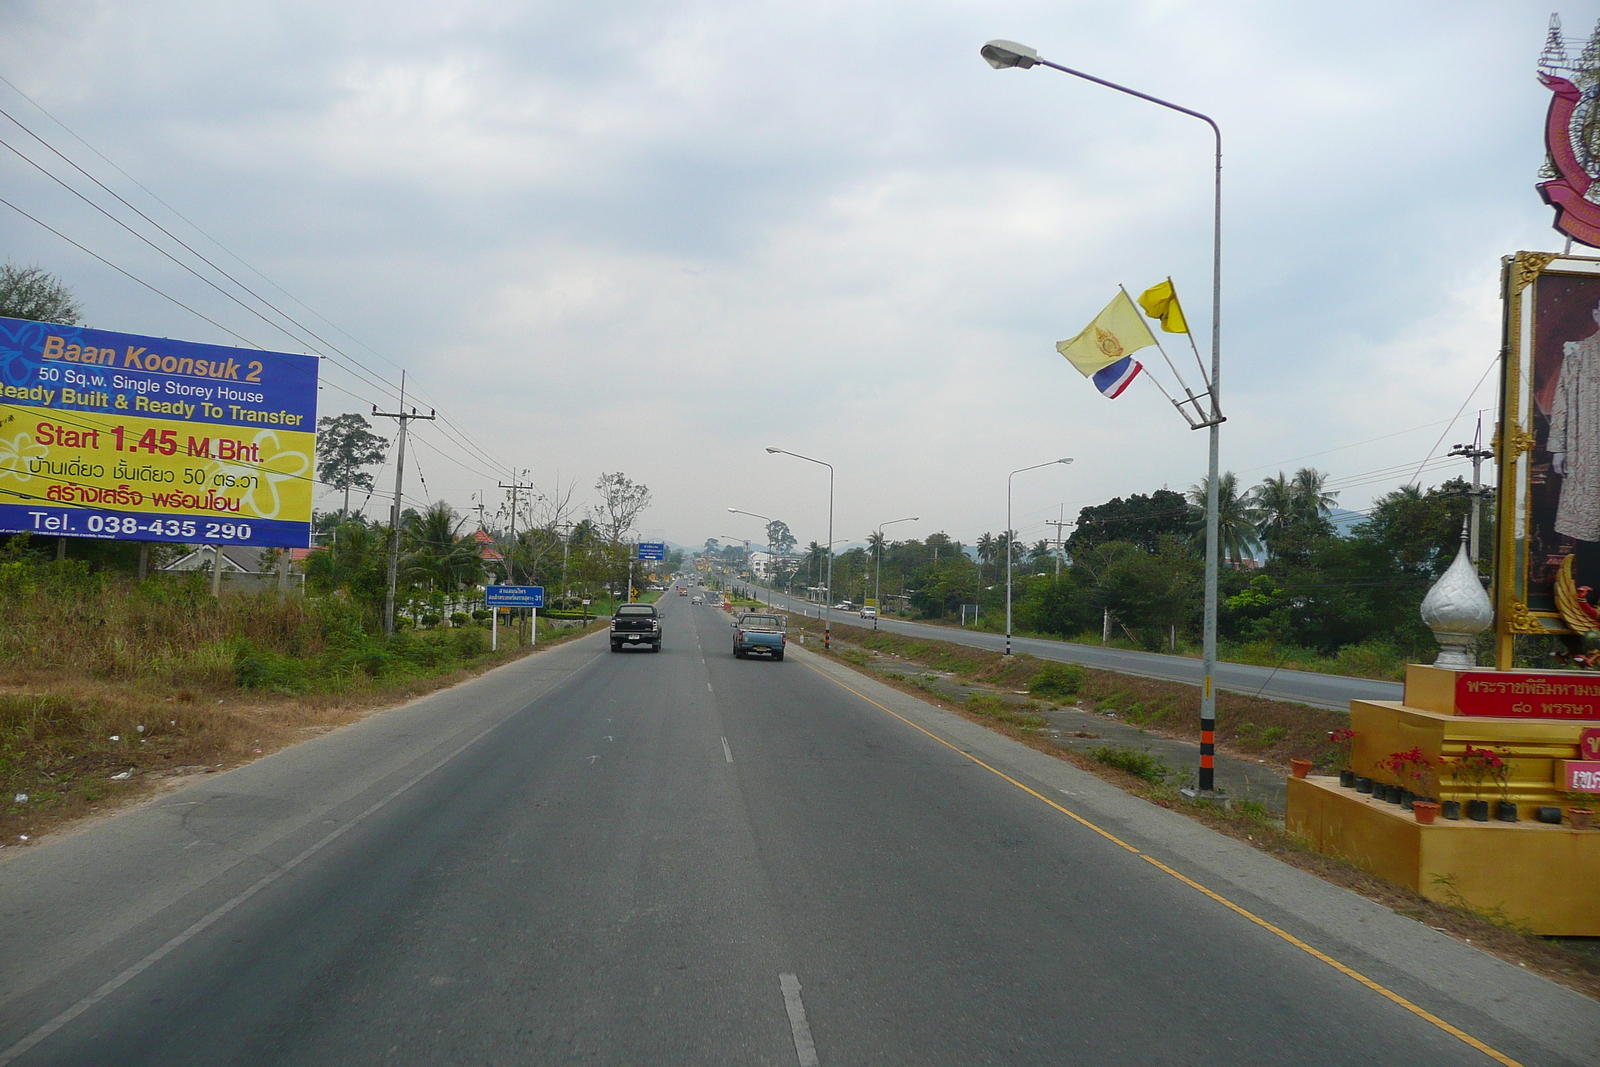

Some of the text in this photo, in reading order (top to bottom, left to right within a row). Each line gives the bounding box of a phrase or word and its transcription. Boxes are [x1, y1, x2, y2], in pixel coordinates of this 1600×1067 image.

[42, 335, 263, 382] Baan Koonsuk 2
[39, 367, 264, 403] 50 Sq.w. Single Storey House
[0, 381, 303, 426] eady Built & Ready To Transfer
[35, 422, 264, 462] Start 1.45 M.Bht.
[29, 455, 259, 489] บ้านเดี่ยว ชั้นเดียว 50 ตร.วา
[46, 483, 240, 512] สร้างเสร็จ พร้อมโอน
[28, 511, 76, 531] Tel.
[87, 515, 196, 538] 038-435
[205, 523, 252, 540] 290
[1541, 703, 1593, 715] พรรษา
